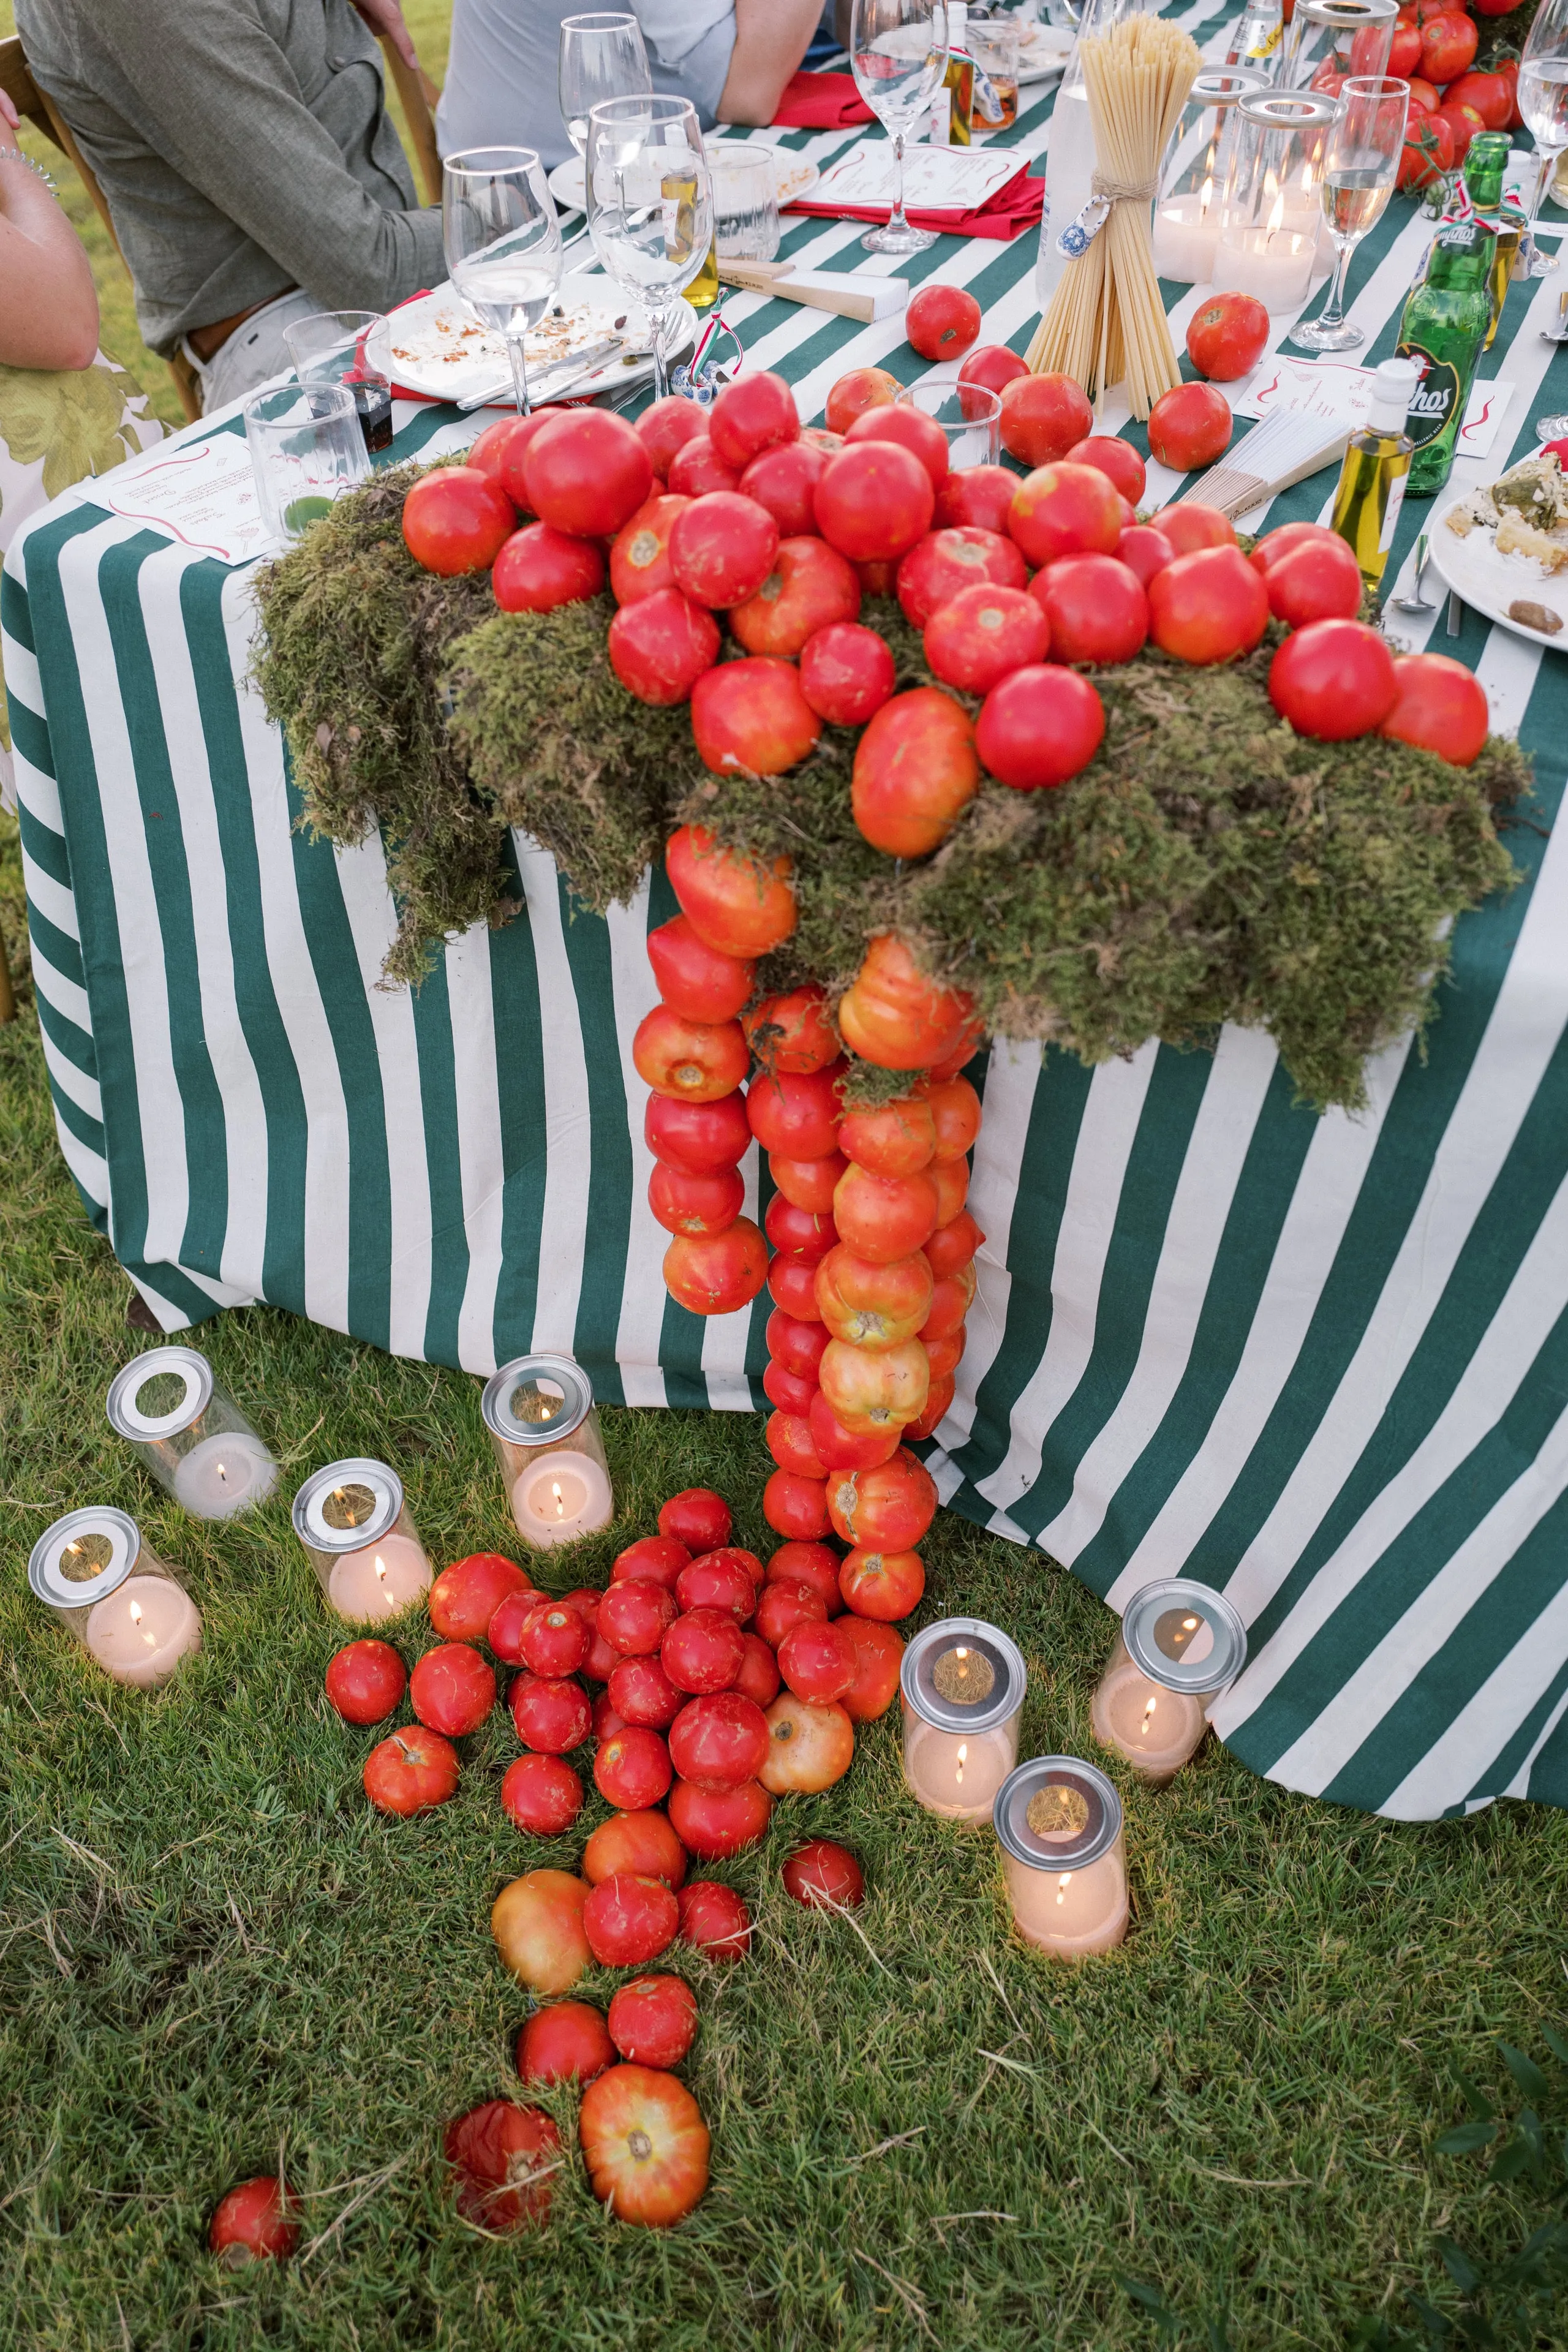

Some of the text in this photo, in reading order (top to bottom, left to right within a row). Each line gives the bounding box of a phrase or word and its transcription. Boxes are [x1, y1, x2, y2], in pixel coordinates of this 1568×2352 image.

[1433, 423, 1442, 434] BEER
[137, 488, 178, 505] Dessert
[187, 510, 228, 527] Salads
